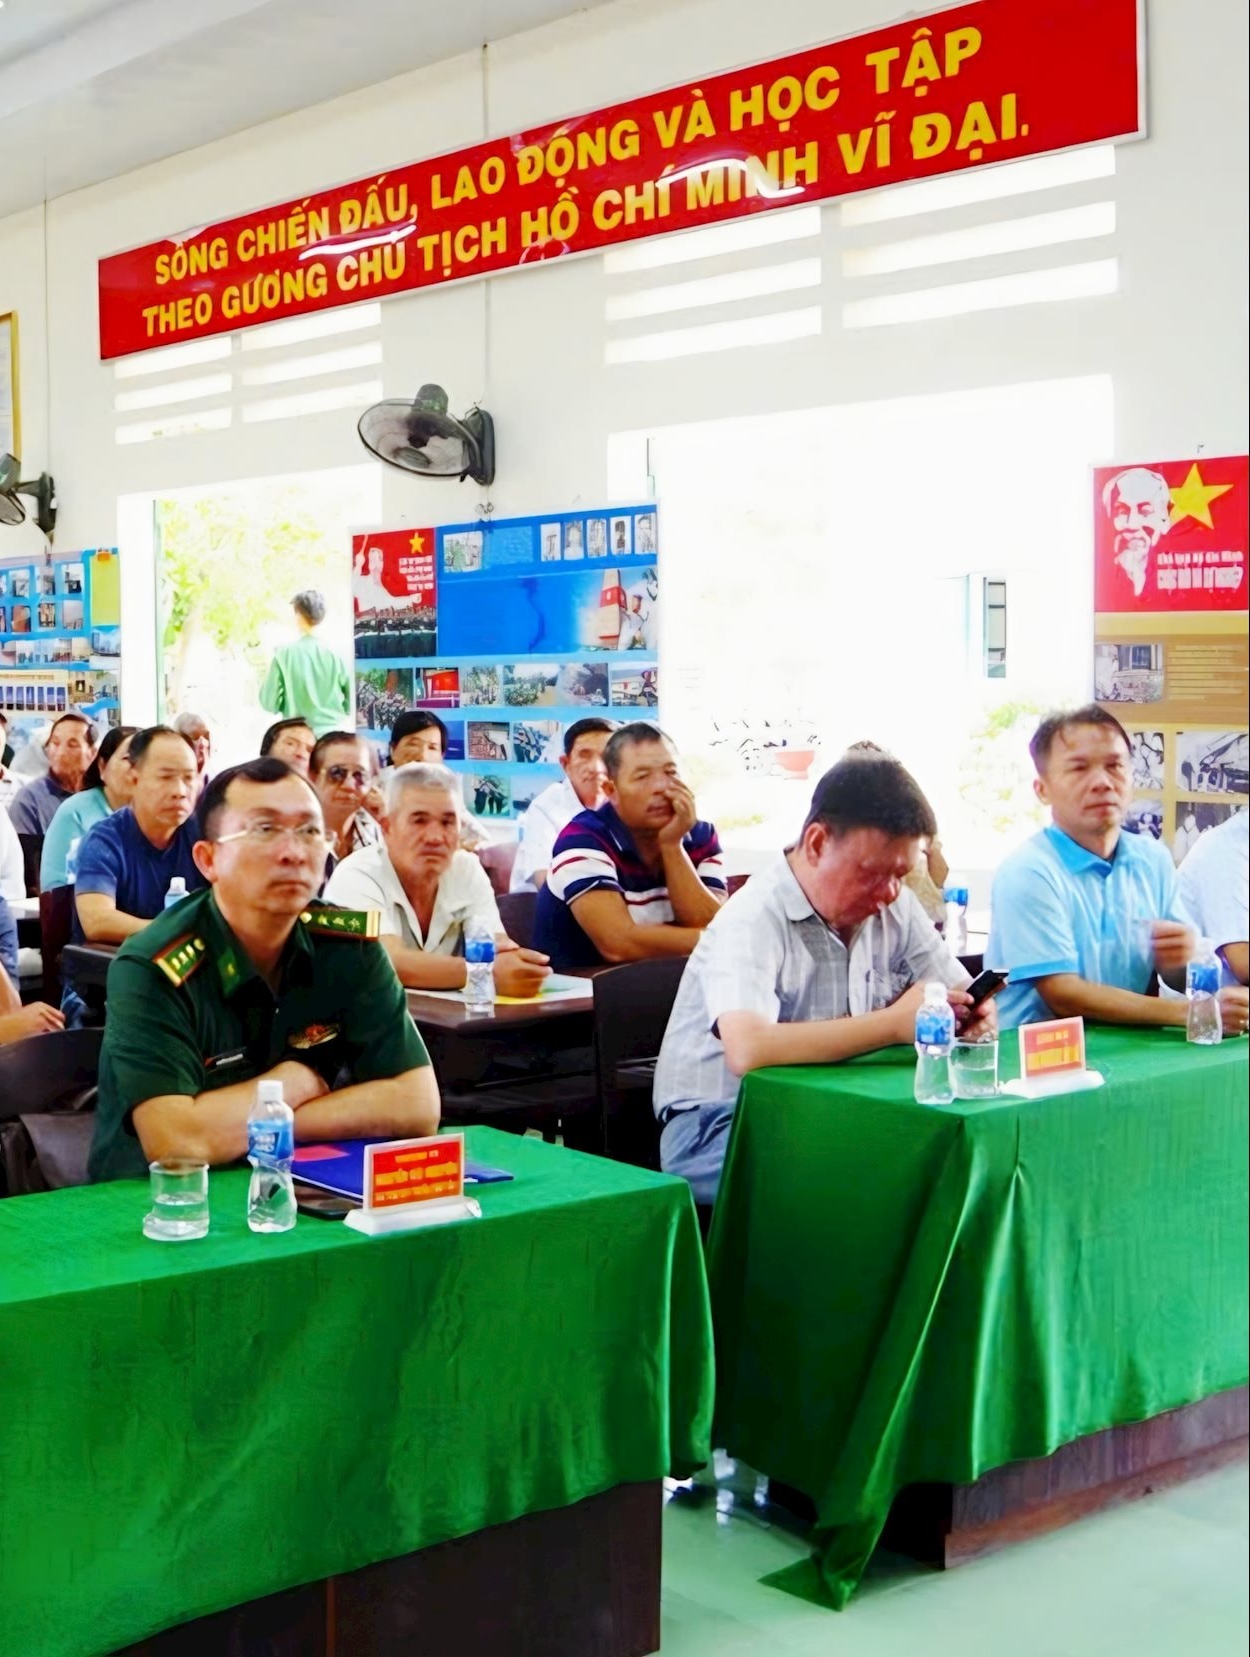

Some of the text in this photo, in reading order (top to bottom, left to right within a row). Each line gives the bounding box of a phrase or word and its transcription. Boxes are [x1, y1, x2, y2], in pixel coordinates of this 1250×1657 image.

[142, 293, 213, 337] THEO
[221, 262, 328, 319] GƯƠNG
[416, 217, 507, 277] TỊCH
[520, 186, 580, 249] HỒ
[592, 163, 675, 231] CHÍ
[686, 141, 819, 211] MINH
[837, 110, 897, 175] VĨ
[909, 93, 1030, 161] ĐẠI.
[237, 199, 331, 262] CHIẾN
[338, 175, 418, 235] ĐẤU,
[431, 156, 506, 210] LAO
[517, 126, 640, 188] ĐỘNG
[652, 89, 717, 149] VÀ
[730, 66, 840, 133] HỌC
[865, 26, 982, 97] TẬP
